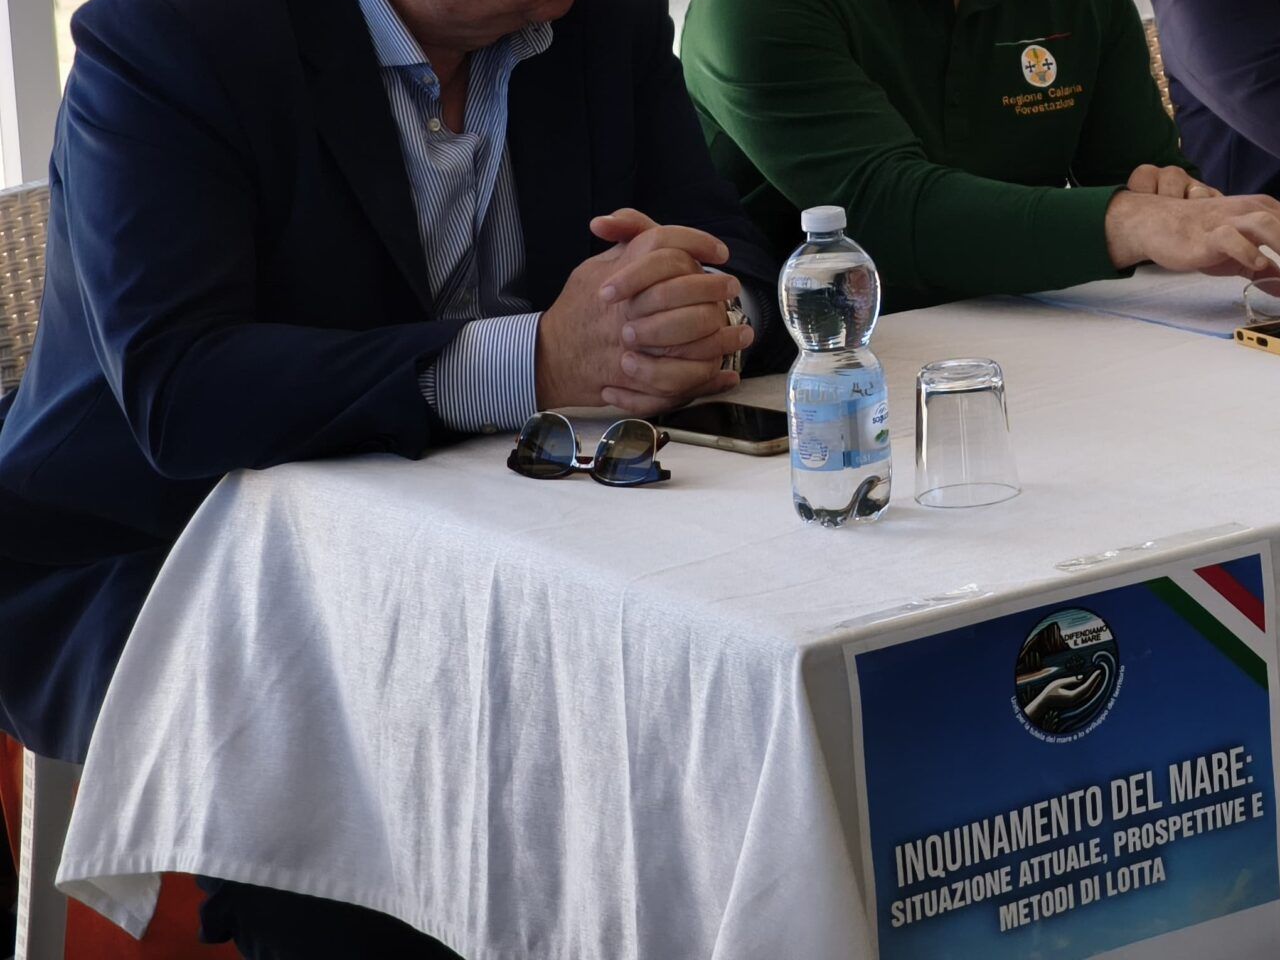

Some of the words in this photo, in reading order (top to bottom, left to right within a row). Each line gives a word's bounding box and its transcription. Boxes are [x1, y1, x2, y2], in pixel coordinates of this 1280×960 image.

[891, 865, 1012, 929] SITUAZIONE
[1019, 838, 1109, 888] ATTUALE,
[1113, 801, 1246, 857] PROSPETTIVE
[1251, 792, 1264, 817] E
[894, 785, 1102, 888] INQUINAMENTO
[1111, 772, 1163, 821] DEL
[1169, 745, 1254, 804] MARE:
[999, 889, 1075, 933] METODI
[1080, 878, 1101, 905] DI
[1106, 856, 1166, 896] LOTTA
